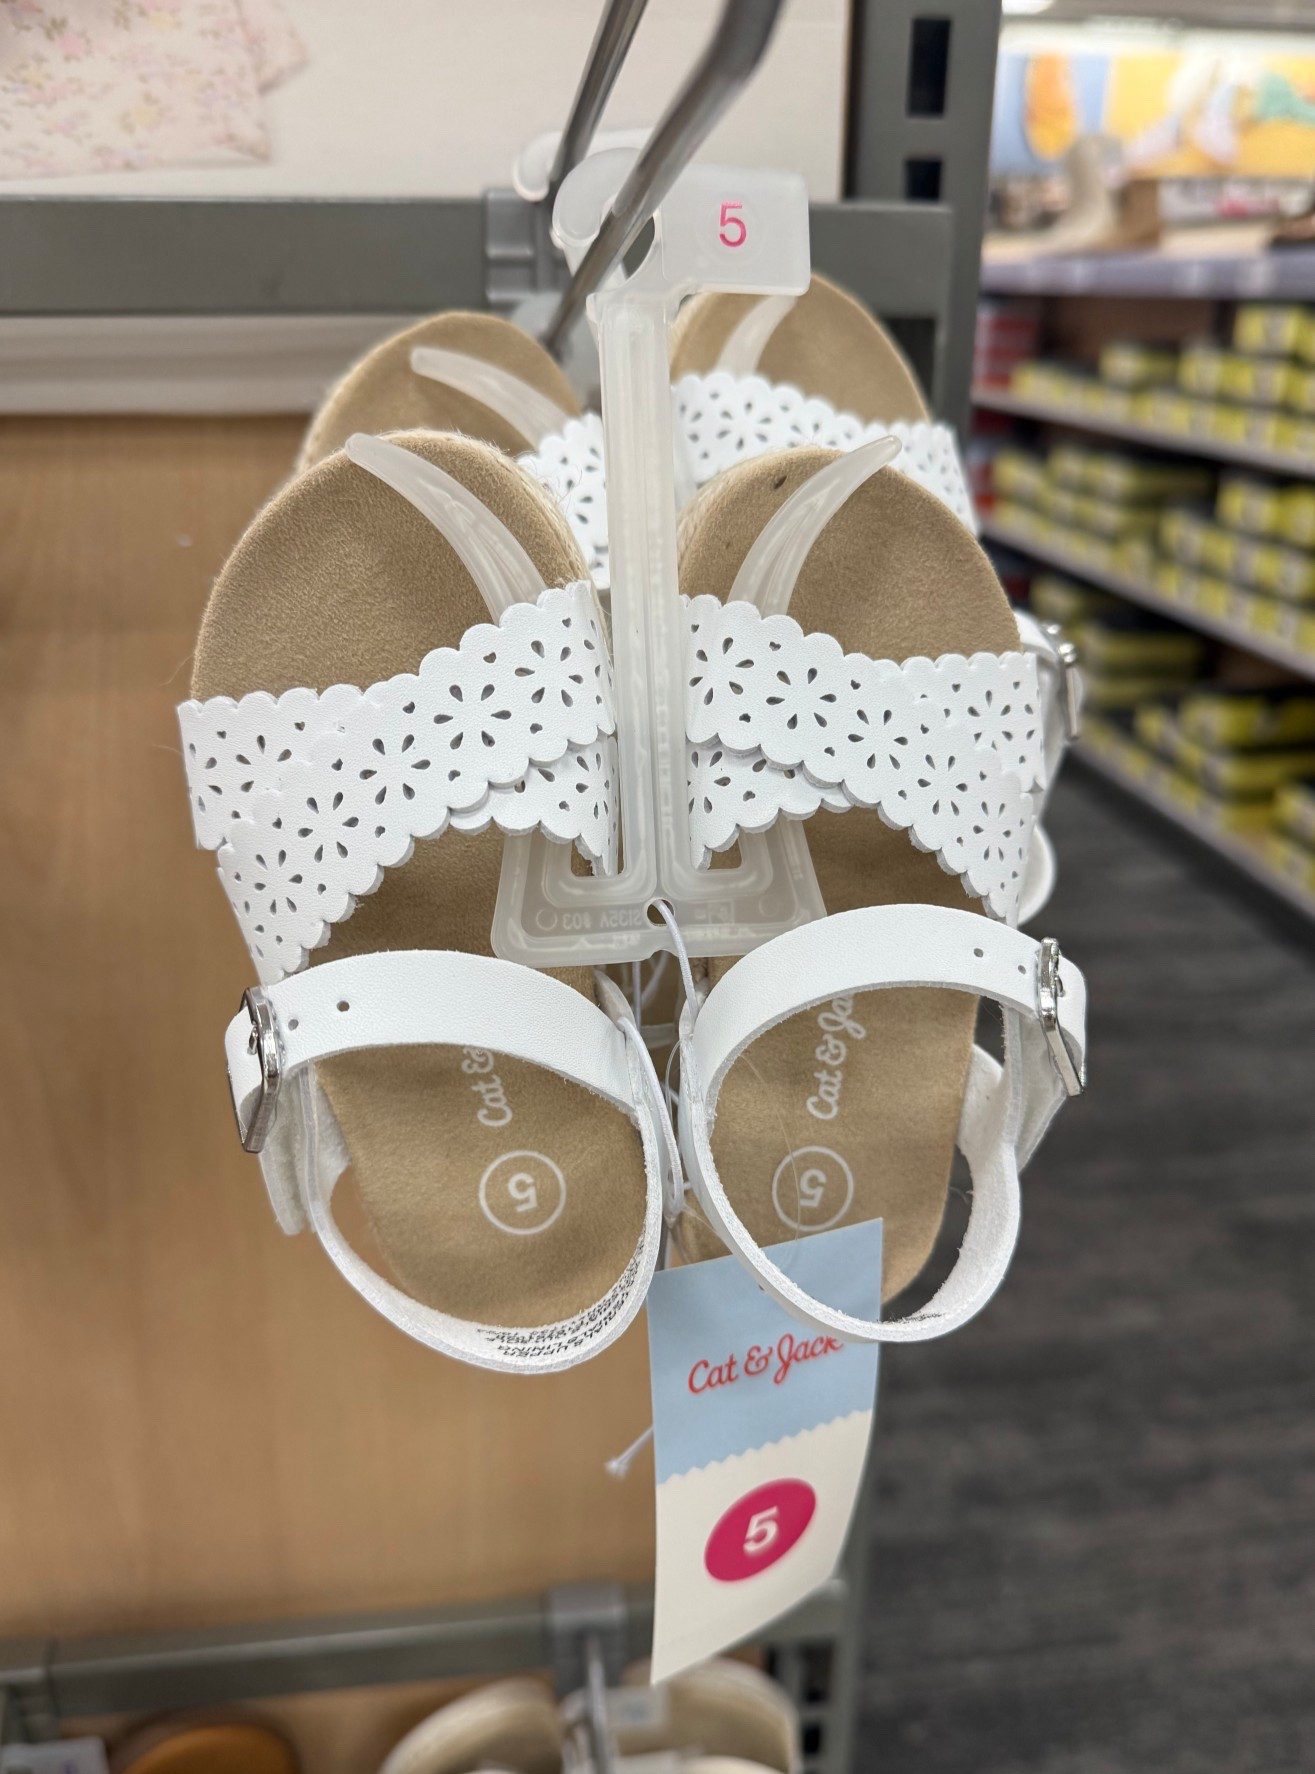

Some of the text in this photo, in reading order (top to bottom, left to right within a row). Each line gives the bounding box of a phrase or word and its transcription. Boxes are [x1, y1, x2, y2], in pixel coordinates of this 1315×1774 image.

[720, 202, 746, 247] 5
[807, 995, 866, 1120] Cat & Ja
[472, 1075, 513, 1127] Cat
[508, 1172, 538, 1212] 5
[800, 1168, 827, 1207] 5
[689, 1333, 844, 1393] Cat & Jack
[743, 1505, 779, 1553] 5
